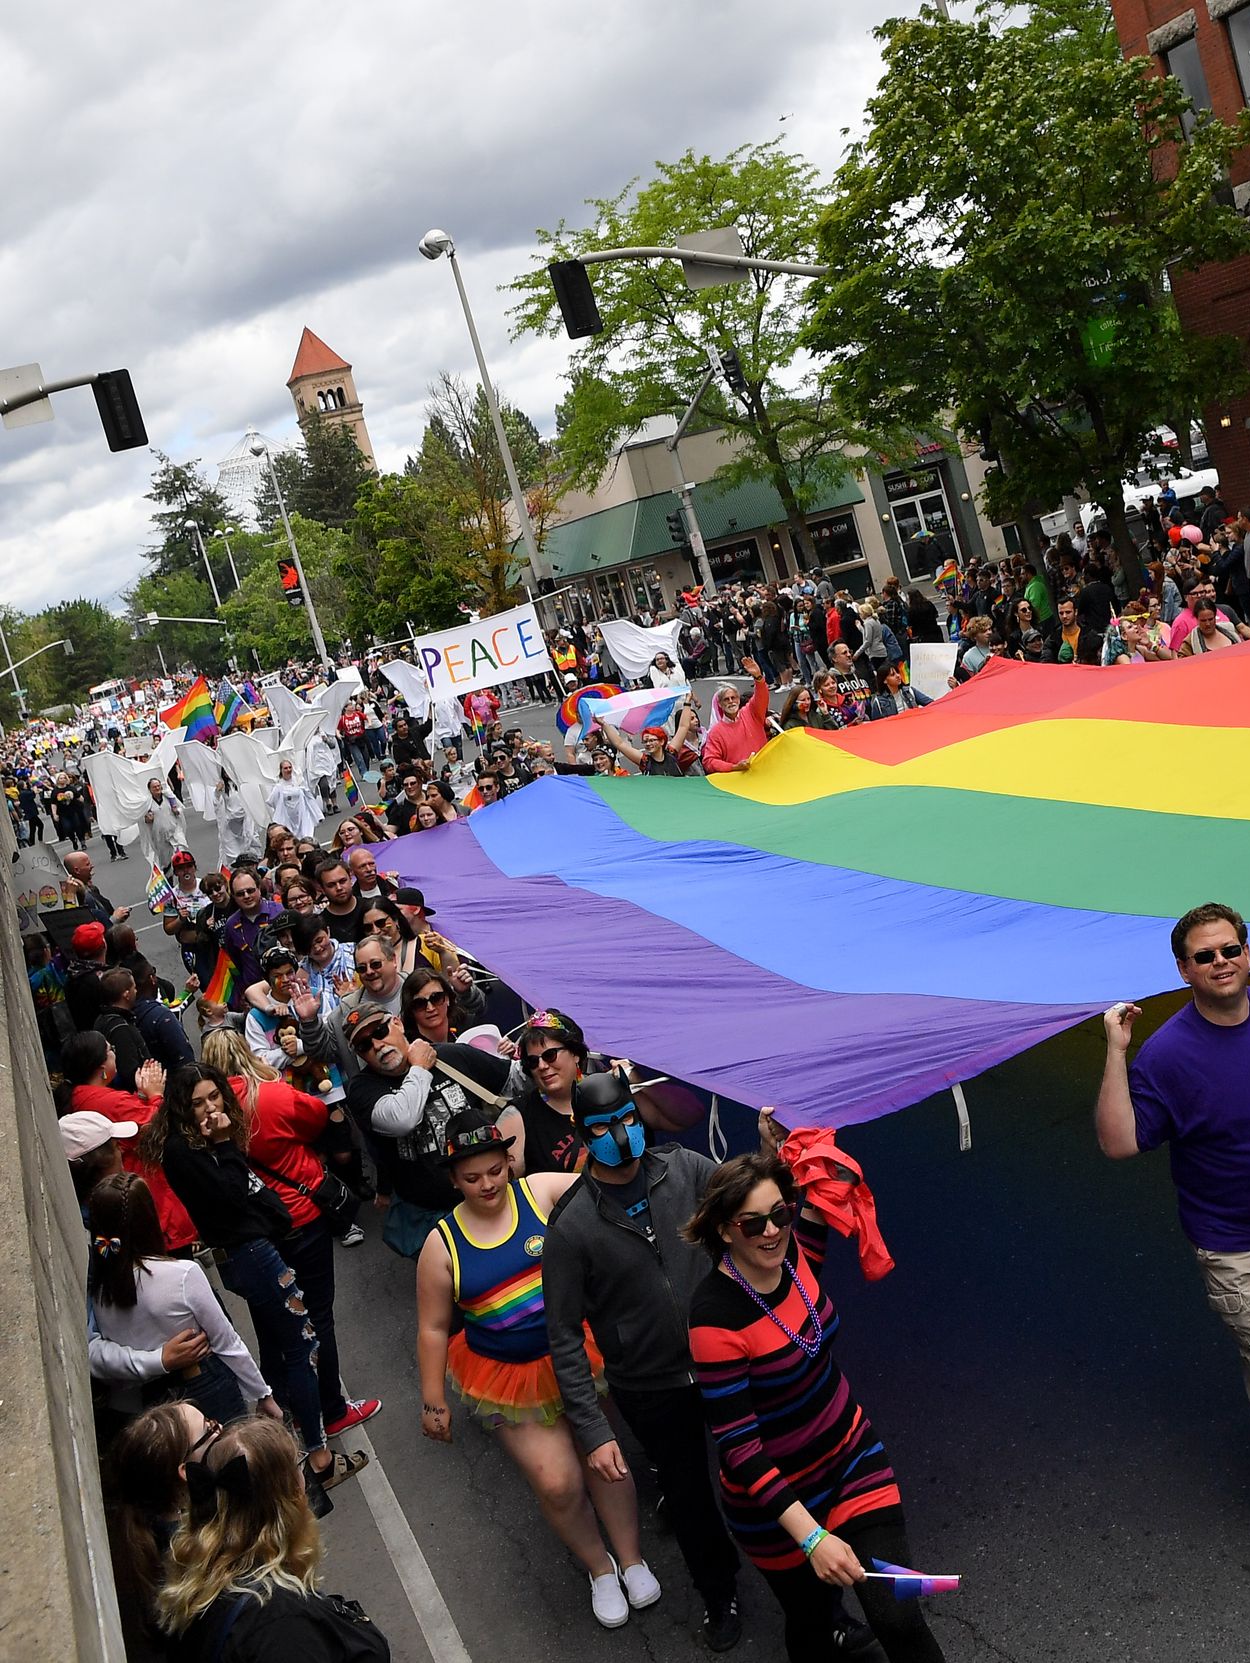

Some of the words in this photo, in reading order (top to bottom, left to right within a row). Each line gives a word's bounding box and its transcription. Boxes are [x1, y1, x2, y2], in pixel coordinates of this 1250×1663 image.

[887, 481, 907, 493] SUSHI
[832, 523, 848, 533] COM
[735, 548, 751, 559] COM
[421, 618, 545, 689] PEACE
[838, 678, 870, 694] PROUD
